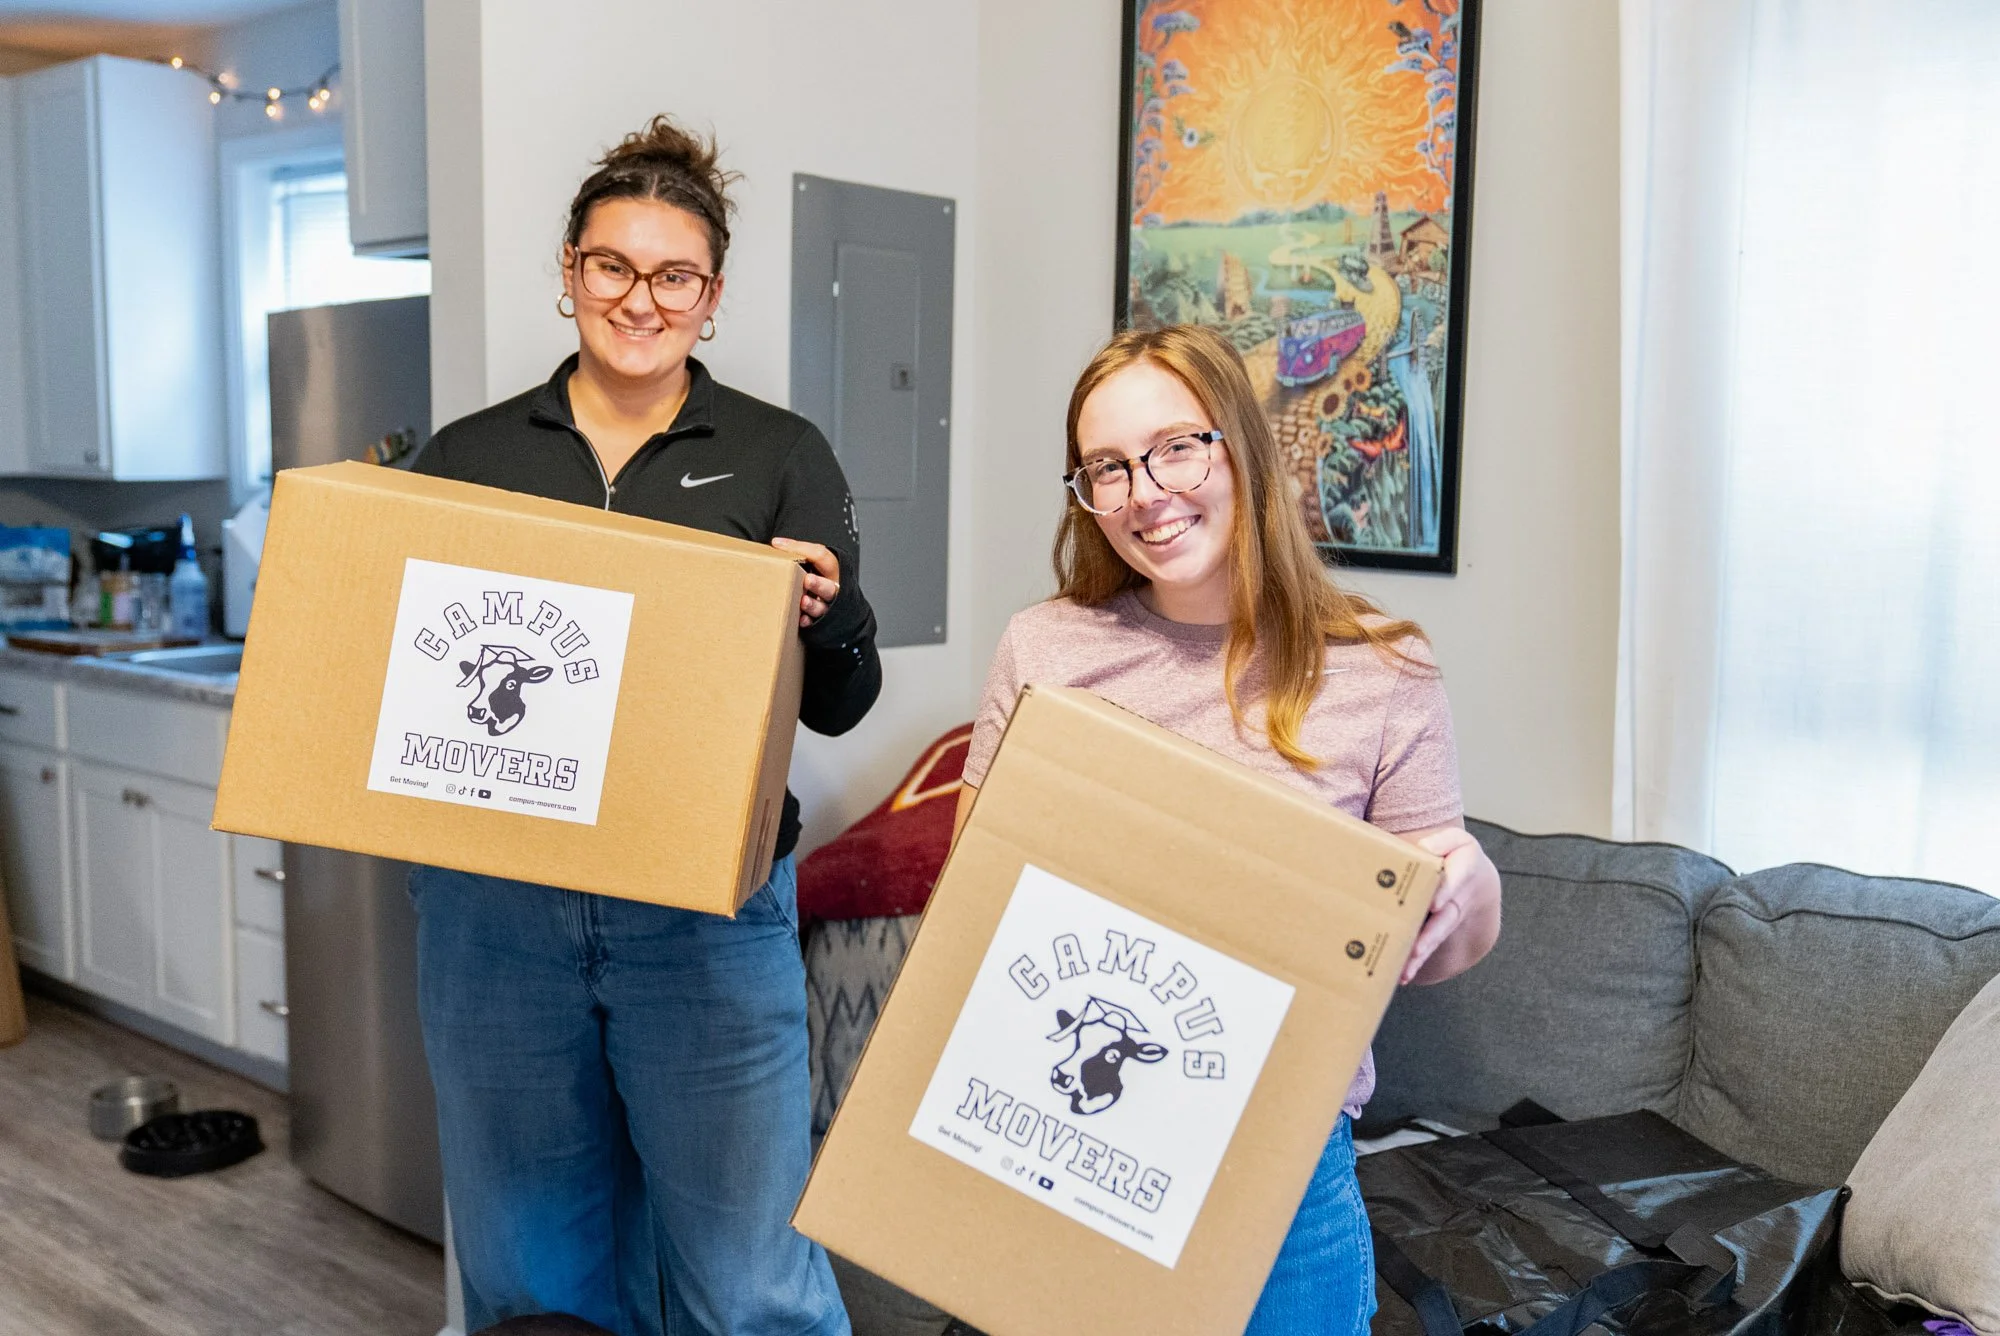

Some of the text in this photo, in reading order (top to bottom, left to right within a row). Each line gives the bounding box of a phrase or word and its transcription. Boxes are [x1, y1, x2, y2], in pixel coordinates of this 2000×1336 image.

[414, 591, 599, 684] CAMPUS
[390, 776, 429, 788] Get Moving!
[401, 732, 579, 791] MOVERS
[1009, 930, 1225, 1079] CAMPUS
[956, 1077, 1171, 1213] MOVERS
